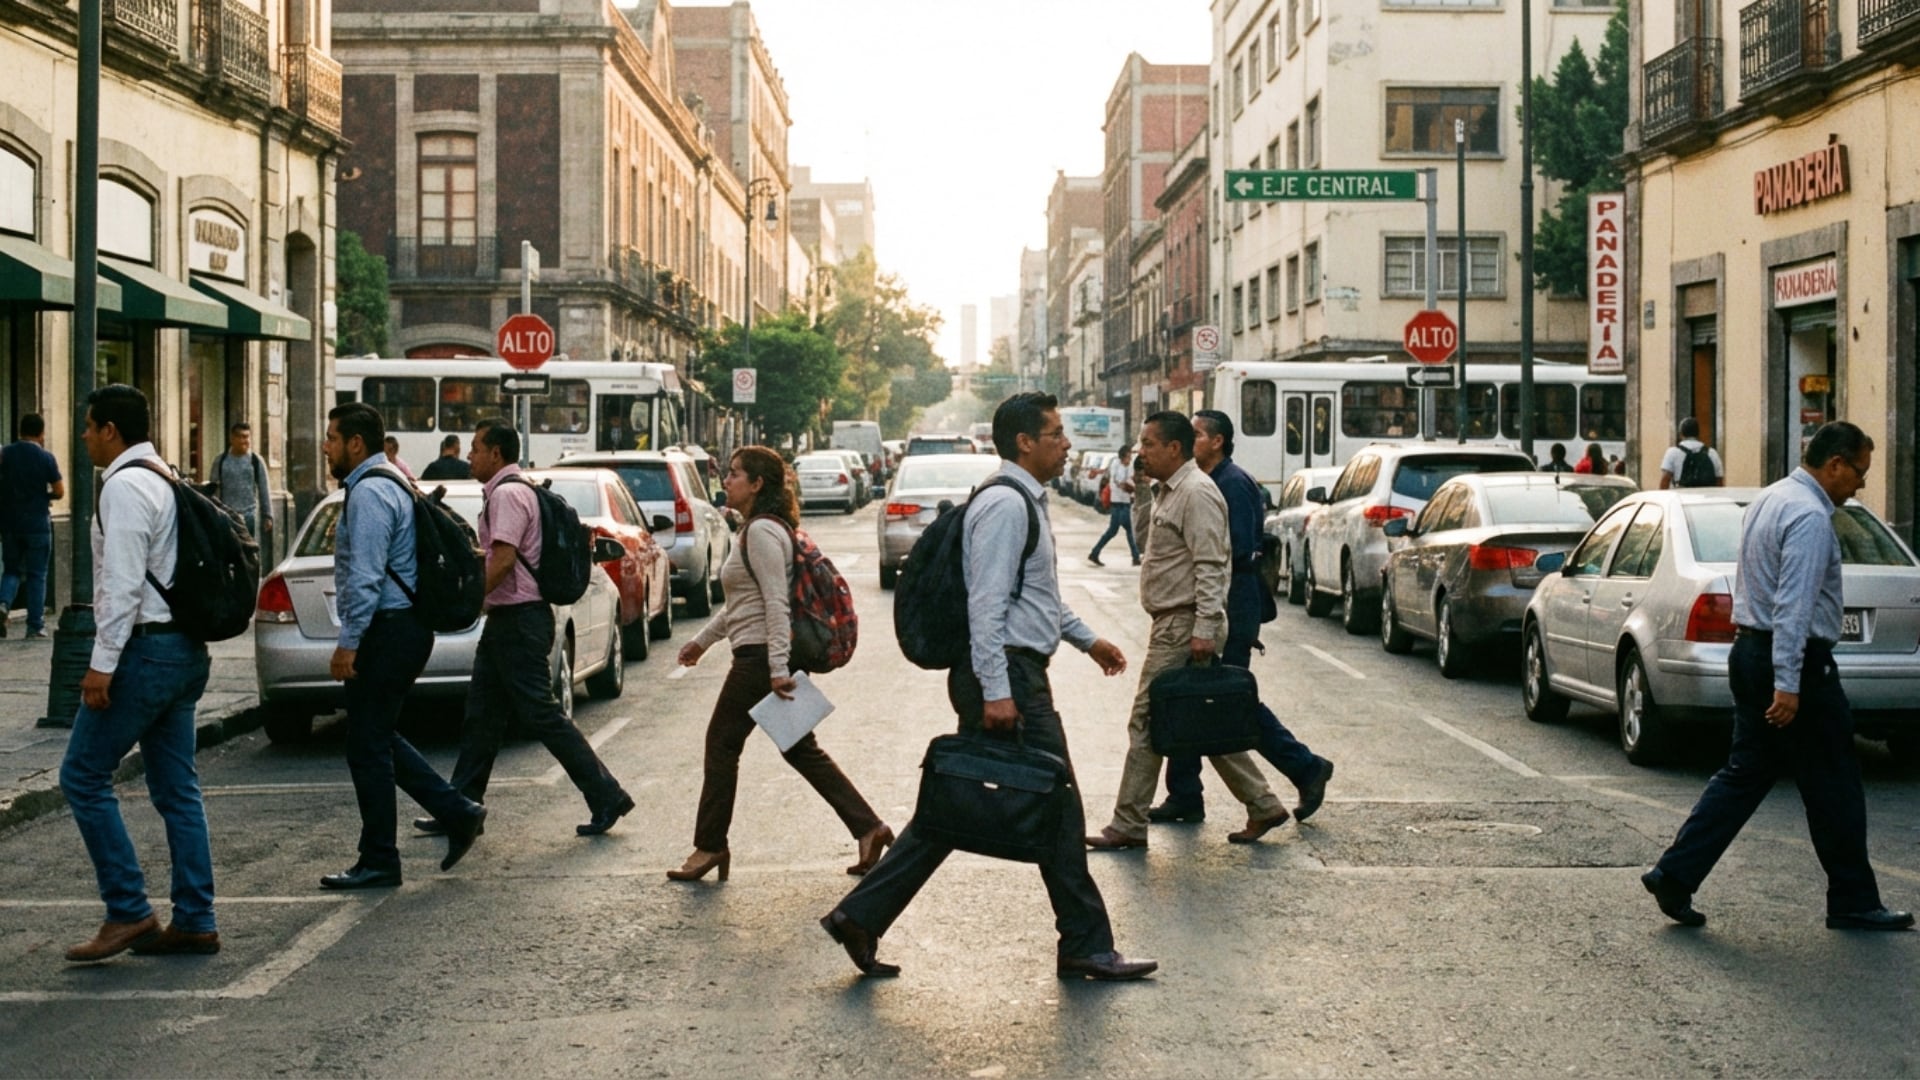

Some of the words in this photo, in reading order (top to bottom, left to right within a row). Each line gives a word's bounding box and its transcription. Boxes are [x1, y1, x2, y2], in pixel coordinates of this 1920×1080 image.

[1754, 133, 1848, 215] PANADERÍA
[1262, 176, 1298, 196] EJE
[1306, 176, 1396, 196] CENTRAL
[501, 331, 551, 354] ALTO
[1408, 326, 1455, 349] ALTO
